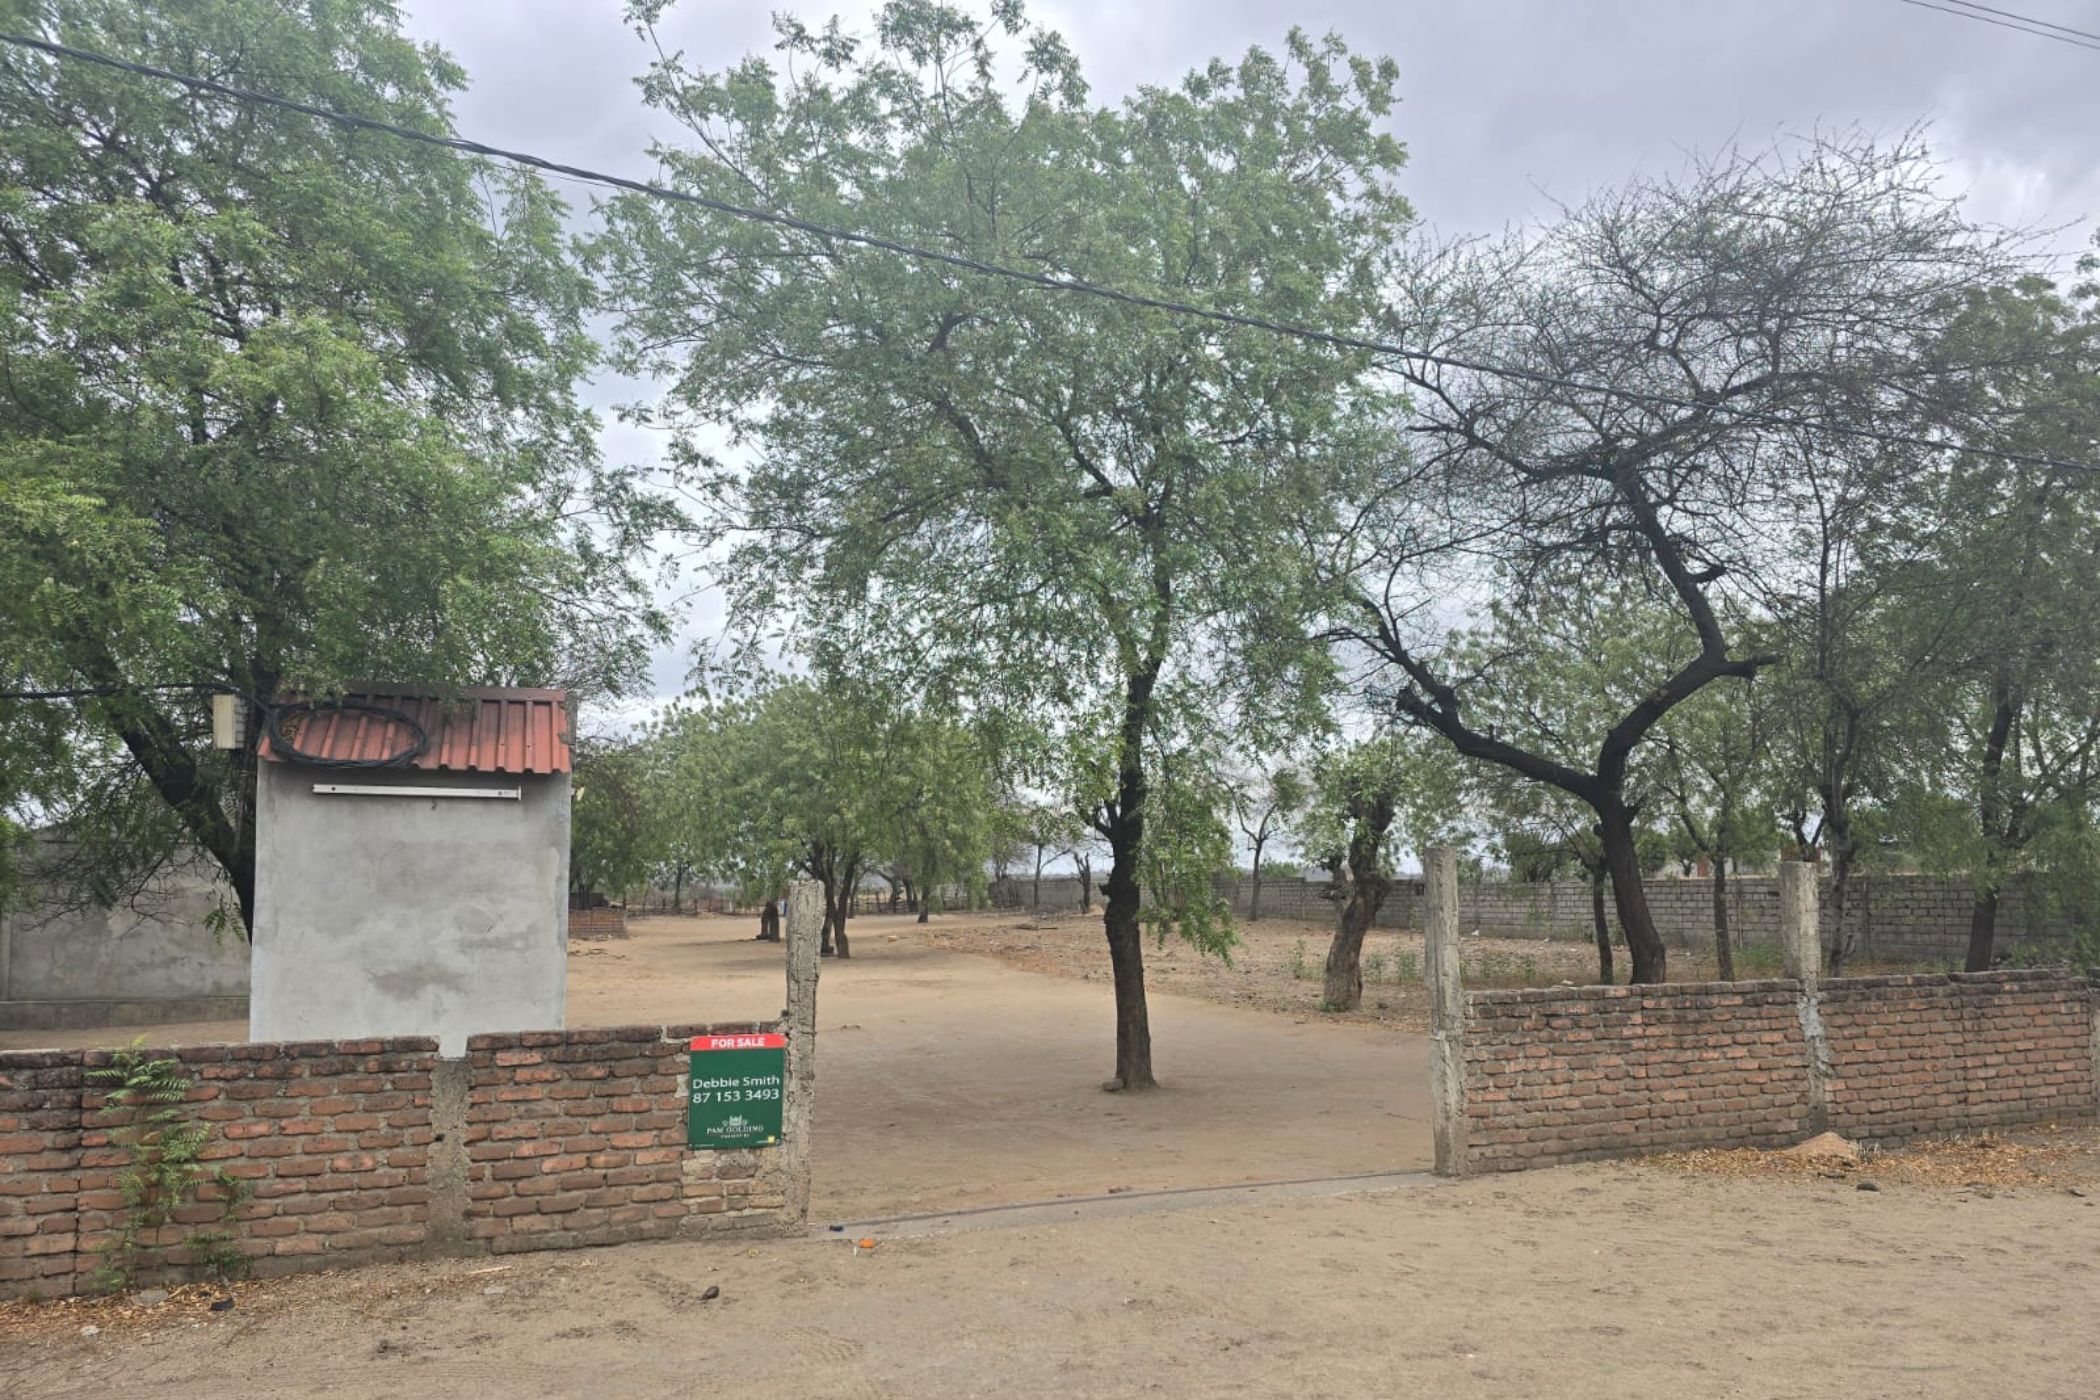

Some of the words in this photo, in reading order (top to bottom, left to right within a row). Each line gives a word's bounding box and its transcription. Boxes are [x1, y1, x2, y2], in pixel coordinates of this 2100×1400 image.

[711, 1038, 735, 1049] FOR
[737, 1037, 766, 1047] SALE
[693, 1077, 740, 1089] Debbie
[743, 1075, 780, 1087] Smith
[693, 1092, 711, 1104] 87
[716, 1090, 741, 1102] 153
[745, 1088, 780, 1101] 3493
